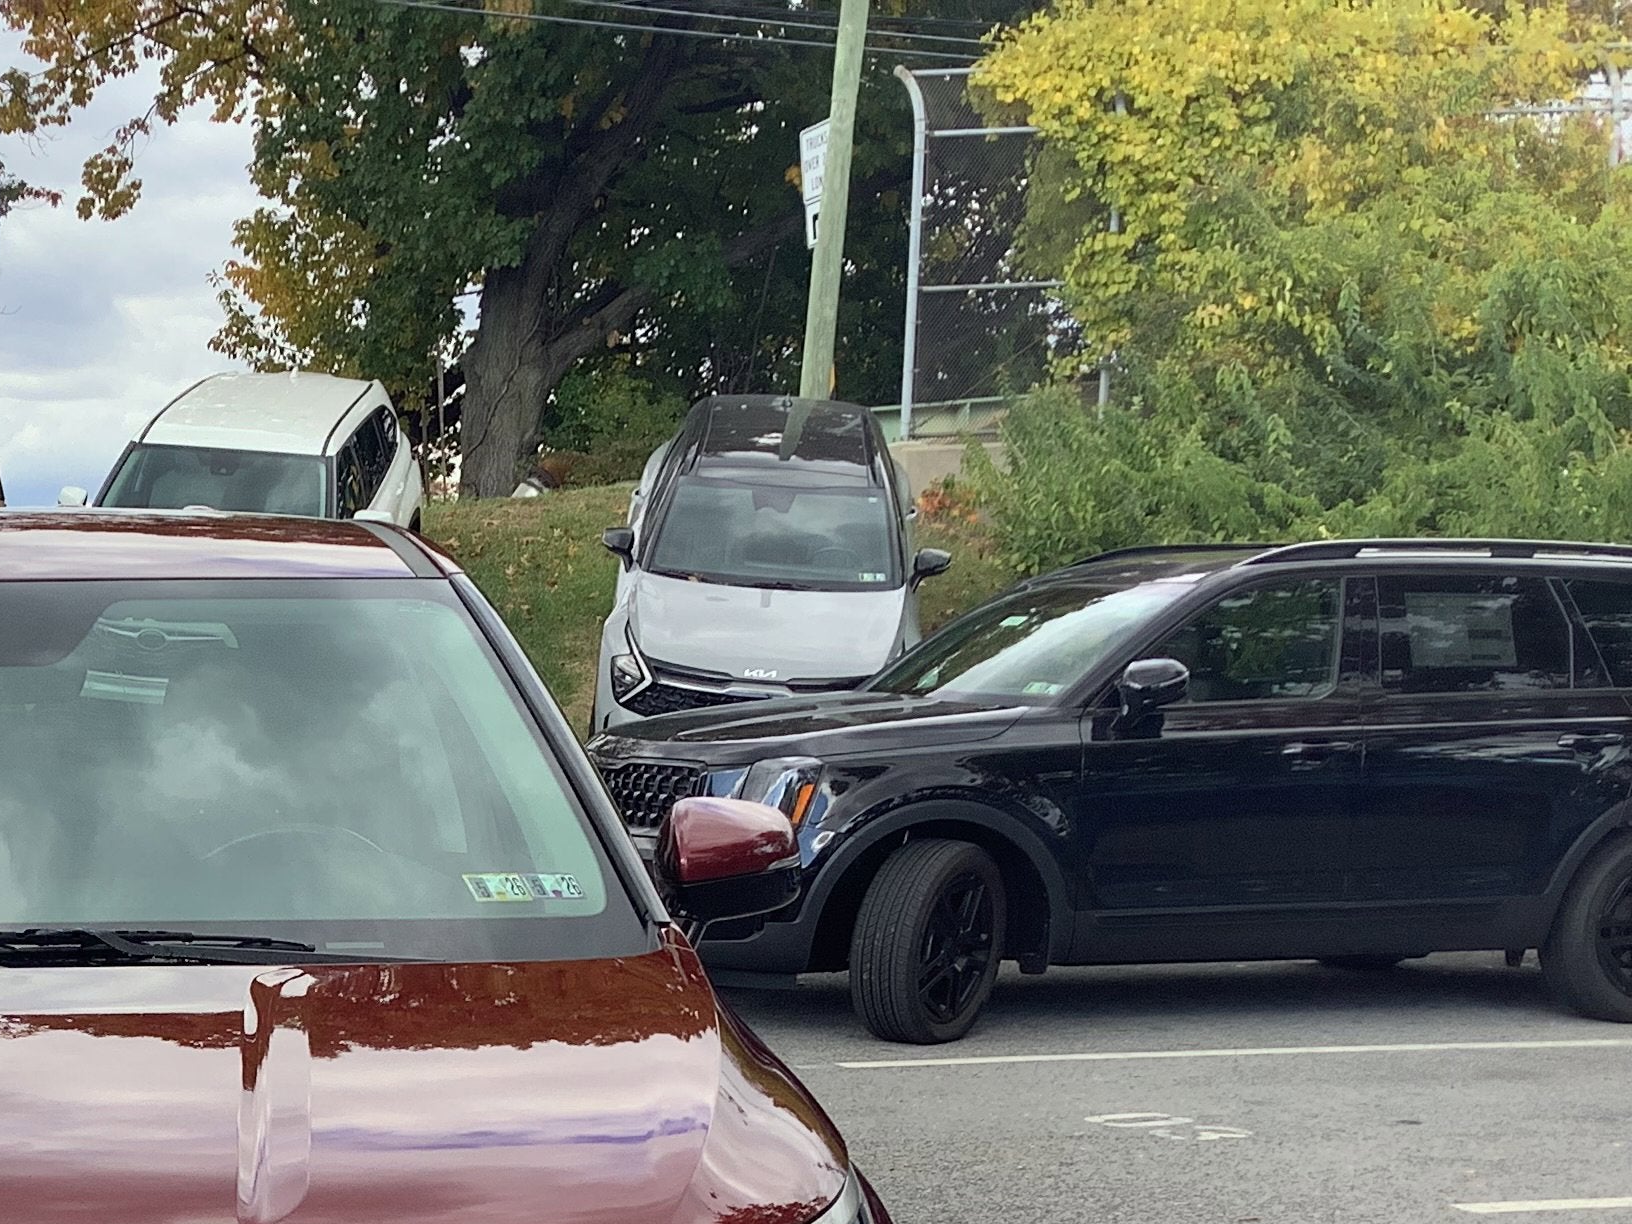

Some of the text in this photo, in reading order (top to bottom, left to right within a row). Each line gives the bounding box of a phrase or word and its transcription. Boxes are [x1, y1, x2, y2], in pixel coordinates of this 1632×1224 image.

[743, 668, 777, 678] KIA
[505, 876, 526, 896] 26
[561, 876, 582, 896] 26
